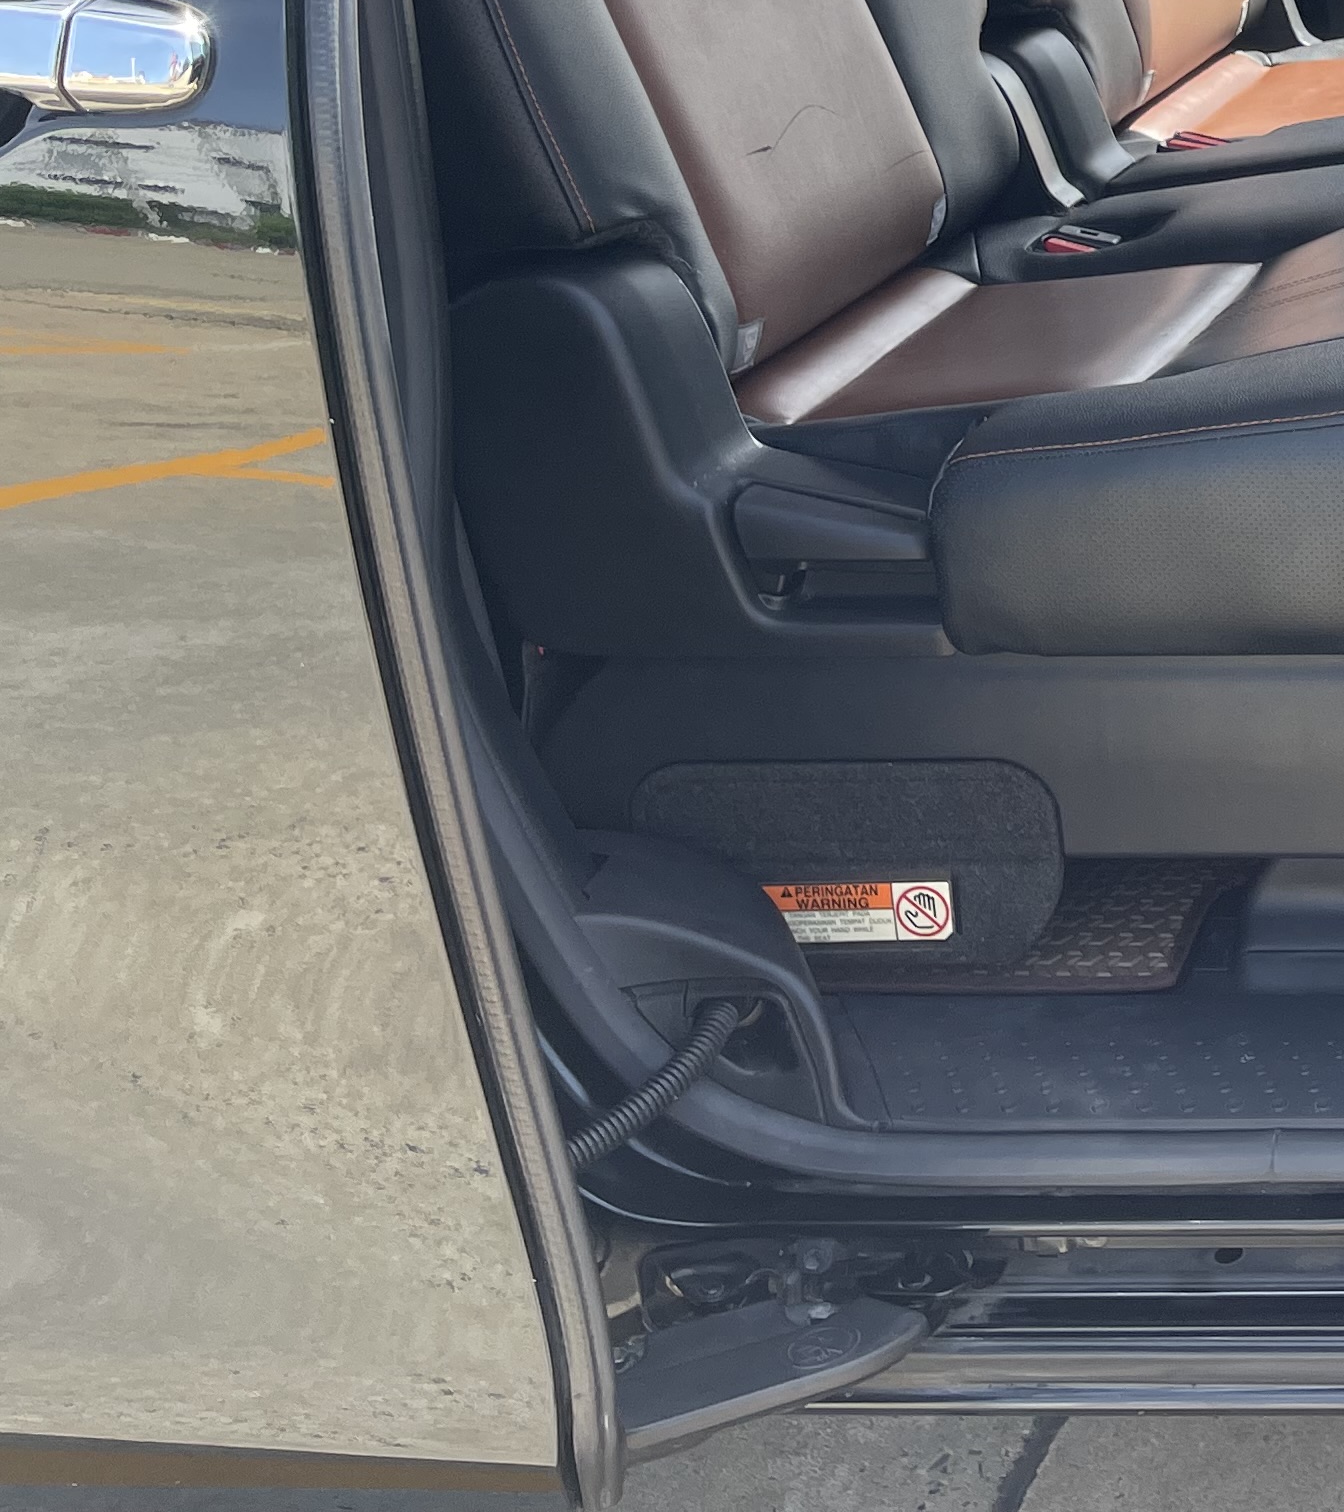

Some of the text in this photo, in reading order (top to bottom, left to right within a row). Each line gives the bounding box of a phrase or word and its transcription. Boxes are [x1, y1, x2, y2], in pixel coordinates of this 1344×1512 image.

[794, 884, 879, 898] PERINGATAN
[795, 897, 870, 910] WARNING
[869, 917, 892, 925] DUDUK
[808, 926, 828, 934] YOUR
